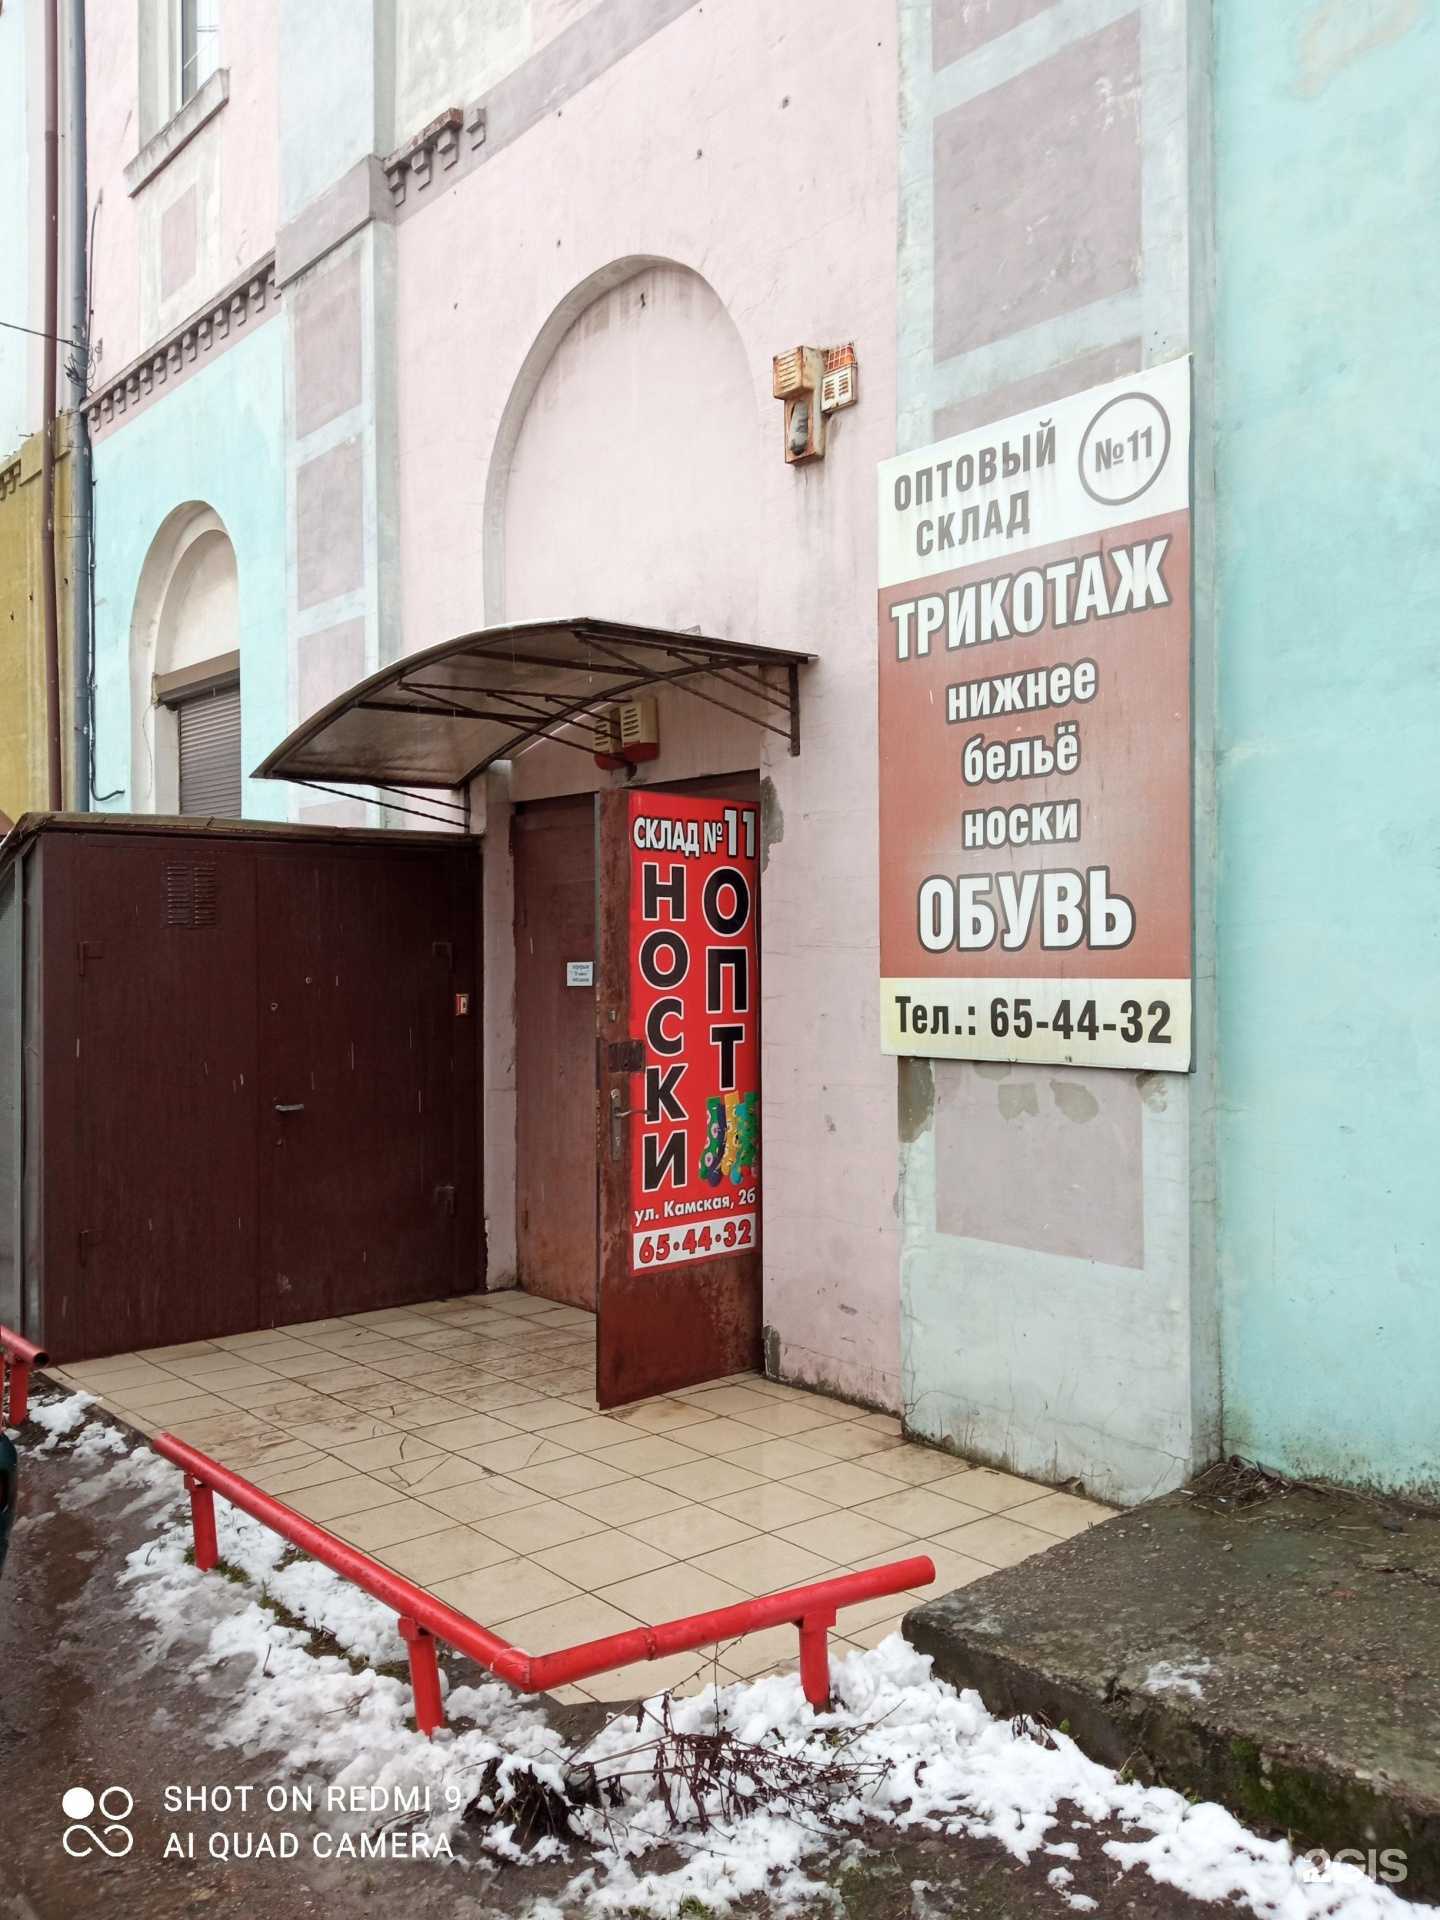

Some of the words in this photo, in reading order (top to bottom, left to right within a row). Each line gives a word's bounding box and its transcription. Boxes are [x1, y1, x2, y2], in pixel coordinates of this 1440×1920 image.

[893, 418, 1056, 512] ОПТОВЫЙ
[916, 490, 1031, 557] СКЛАД
[890, 536, 1171, 660] ТРИКОТАЖ
[946, 660, 1097, 723] нижнее
[963, 722, 1080, 784] бельё
[633, 816, 700, 857] СКЛАД
[963, 800, 1080, 849] носки
[917, 867, 1135, 952] ОБУВЬ
[702, 866, 751, 1091] ОПТ
[638, 861, 691, 1193] НОСКИ
[895, 995, 976, 1036] Тел.:
[990, 997, 1172, 1044] 65-44-32
[634, 1207, 660, 1227] ул.
[664, 1195, 735, 1218] Камская,
